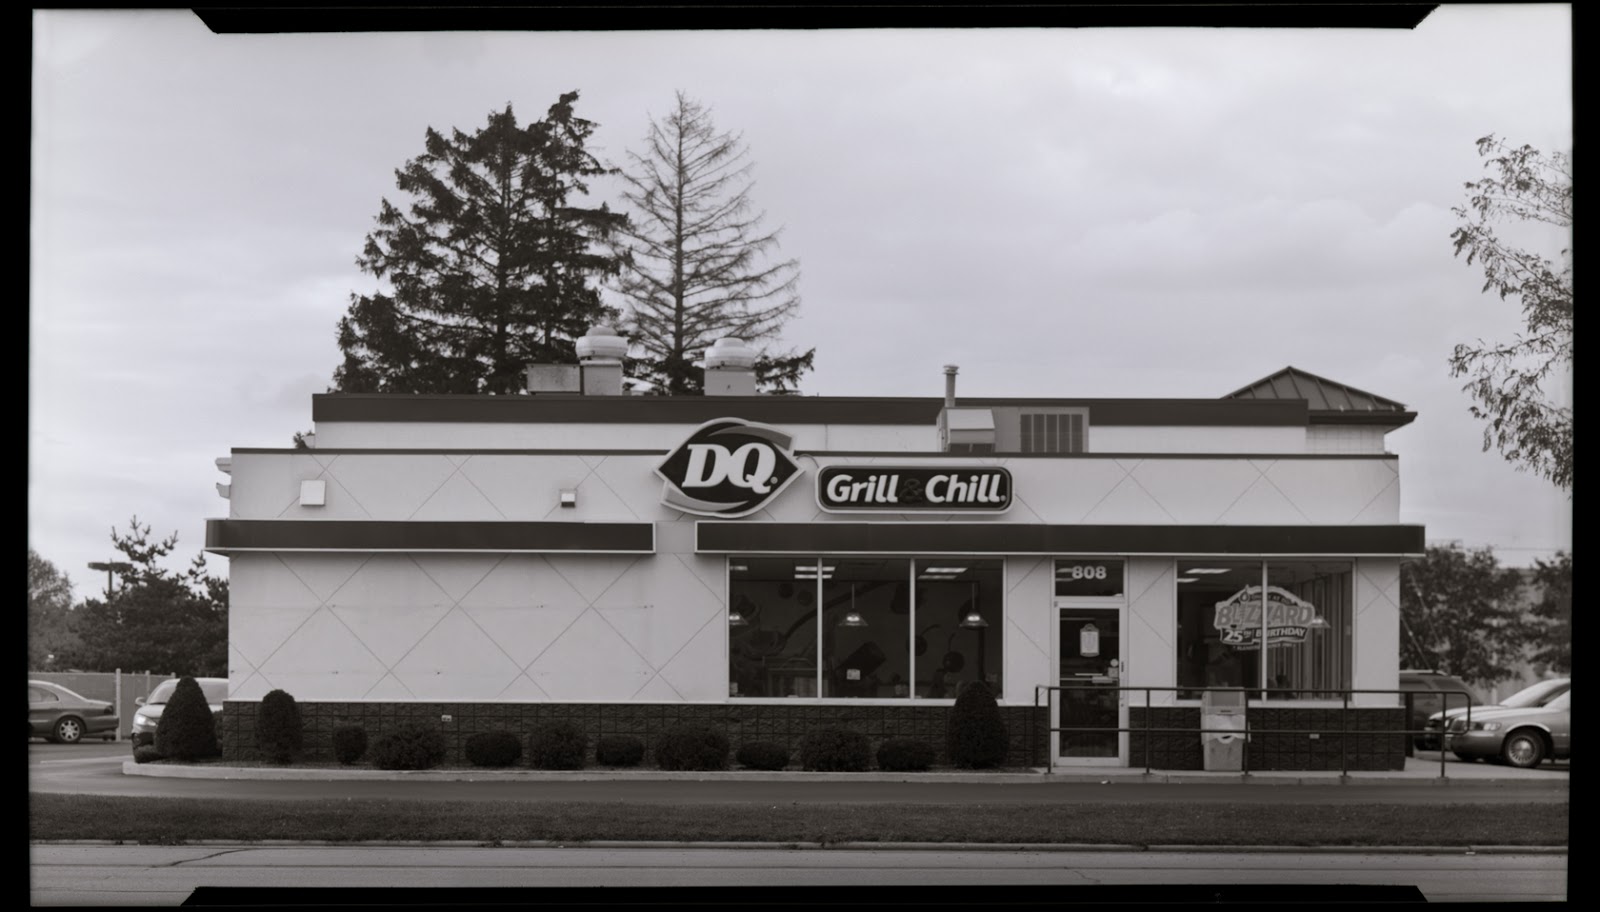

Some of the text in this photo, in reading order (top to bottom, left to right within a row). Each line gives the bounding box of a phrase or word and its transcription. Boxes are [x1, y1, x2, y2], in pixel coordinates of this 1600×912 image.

[682, 442, 777, 495] DQ
[826, 473, 1003, 505] Grill & Chill
[1071, 565, 1107, 580] 808
[1216, 603, 1313, 627] BLIZZARD
